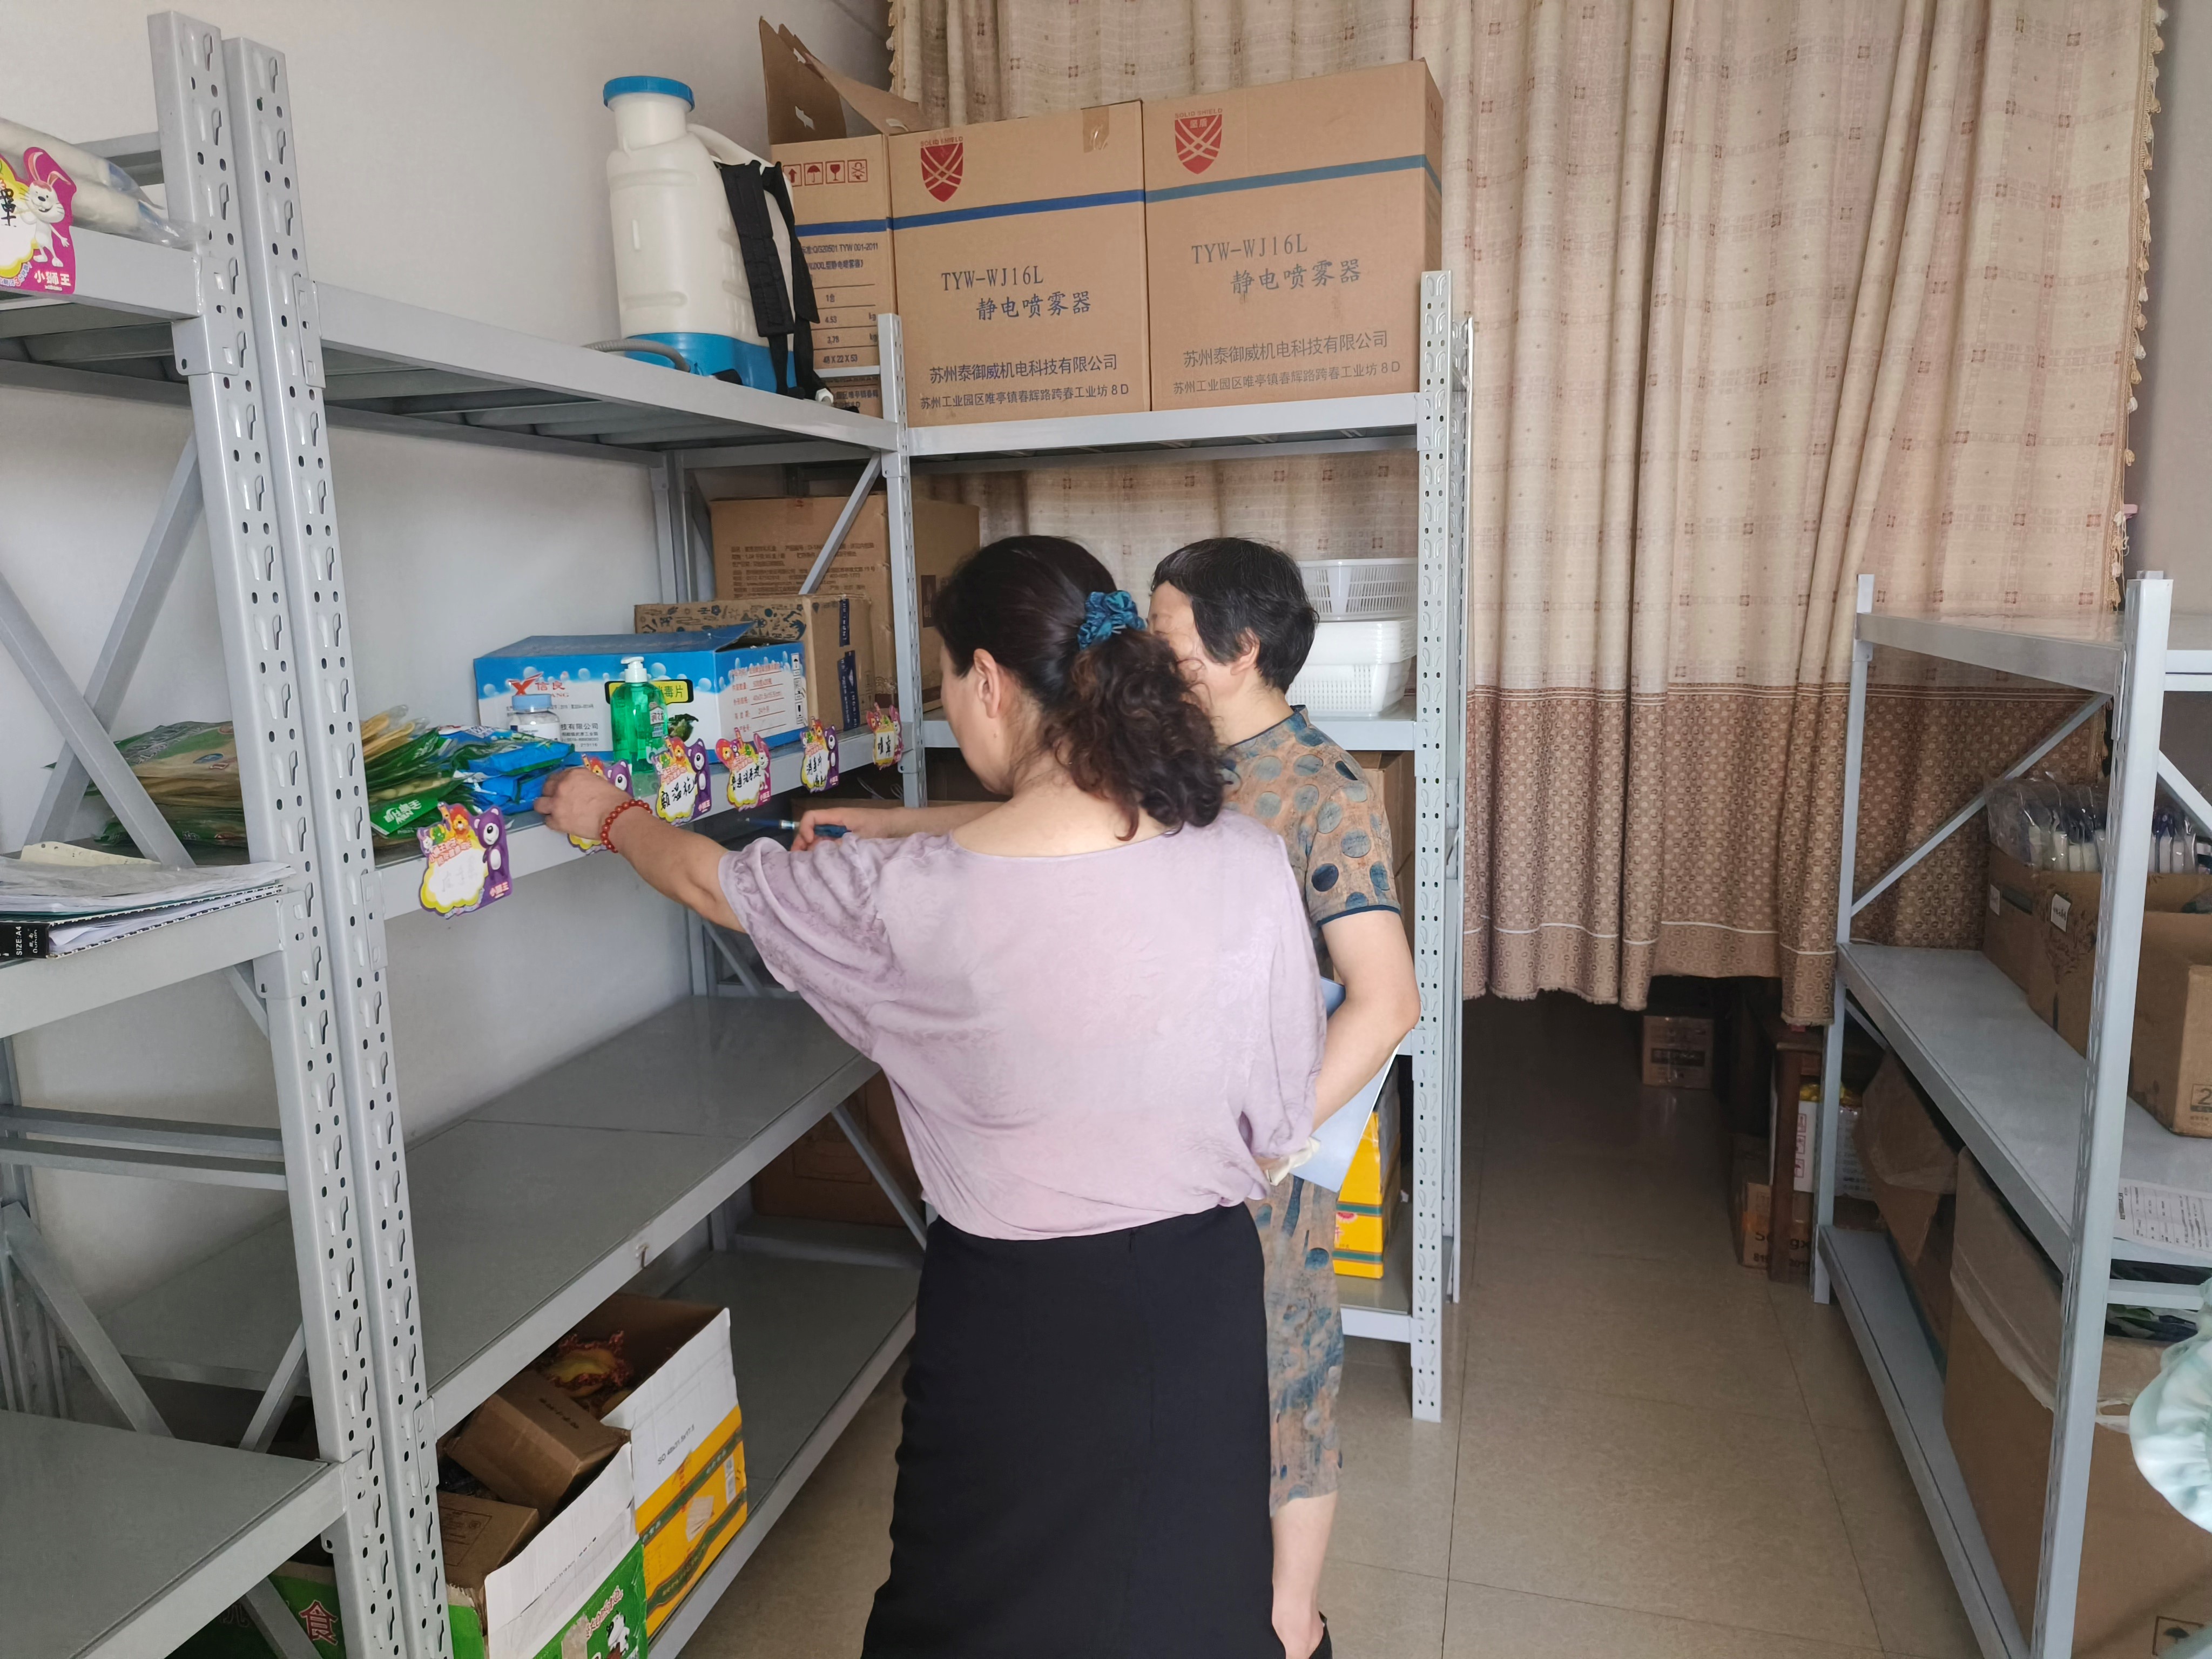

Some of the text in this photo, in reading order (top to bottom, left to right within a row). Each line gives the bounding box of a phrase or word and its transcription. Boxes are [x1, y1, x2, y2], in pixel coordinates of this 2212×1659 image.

[1197, 107, 1223, 116] SHIELD
[920, 139, 939, 147] SOLID
[1191, 233, 1307, 264] TYW-WJ16L
[34, 270, 71, 286] 小狮王
[941, 265, 1043, 291] TYW-WJ16L
[1230, 258, 1361, 294] 静电喷雾器
[825, 312, 876, 323] 4.53 kg
[976, 291, 1091, 321] 静电喷雾器
[1183, 330, 1387, 368] 苏州泰御威机电科技有限公司
[929, 354, 1117, 384] 苏州泰御威机电科技有限公司
[298, 1599, 339, 1646] 食
